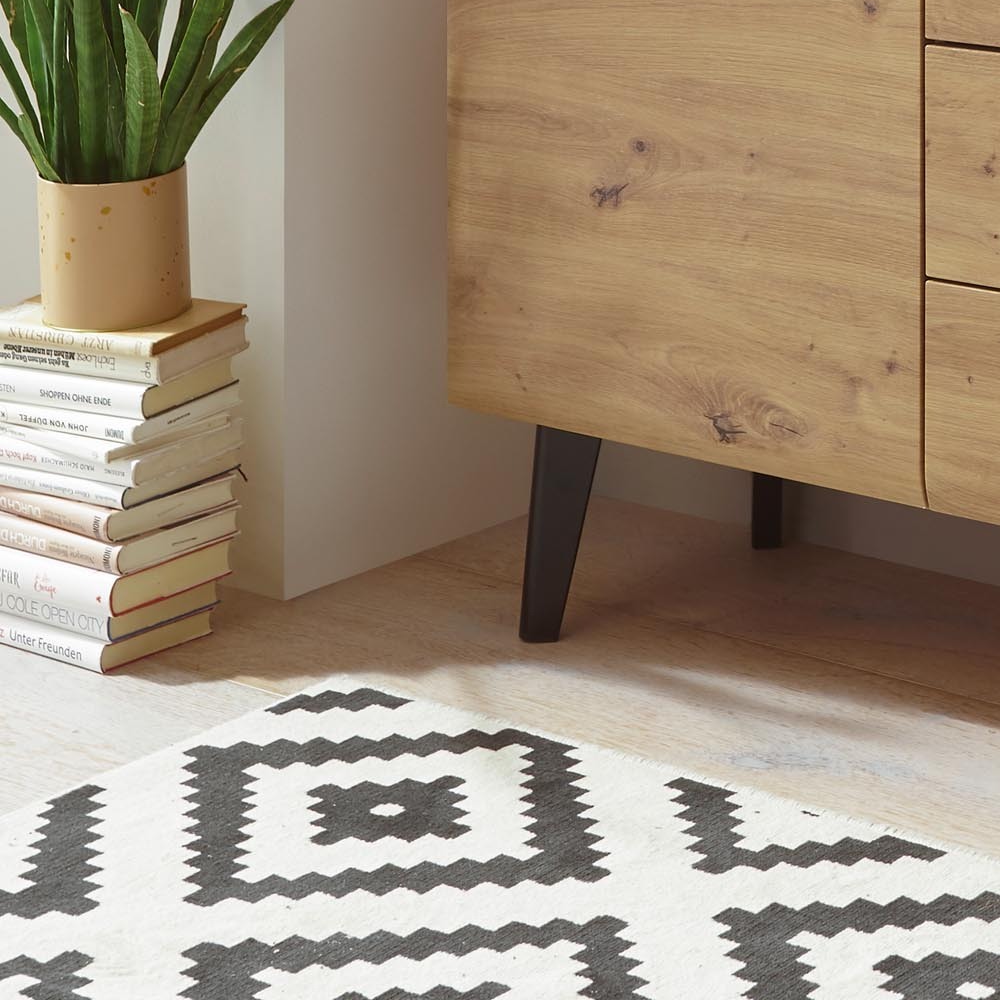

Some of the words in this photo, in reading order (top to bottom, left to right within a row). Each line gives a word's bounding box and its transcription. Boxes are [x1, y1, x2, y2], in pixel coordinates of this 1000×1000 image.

[8, 328, 74, 346] CHRISTIAN
[40, 389, 70, 401] SHOPPEN
[73, 394, 92, 404] OHNE
[94, 397, 111, 406] ENDE
[49, 419, 66, 428] VON
[68, 423, 88, 432] JOHN
[7, 595, 38, 616] COLE
[41, 604, 75, 626] OPEN
[78, 614, 105, 634] CITY
[10, 629, 36, 647] Unter
[39, 638, 82, 661] Freunden
